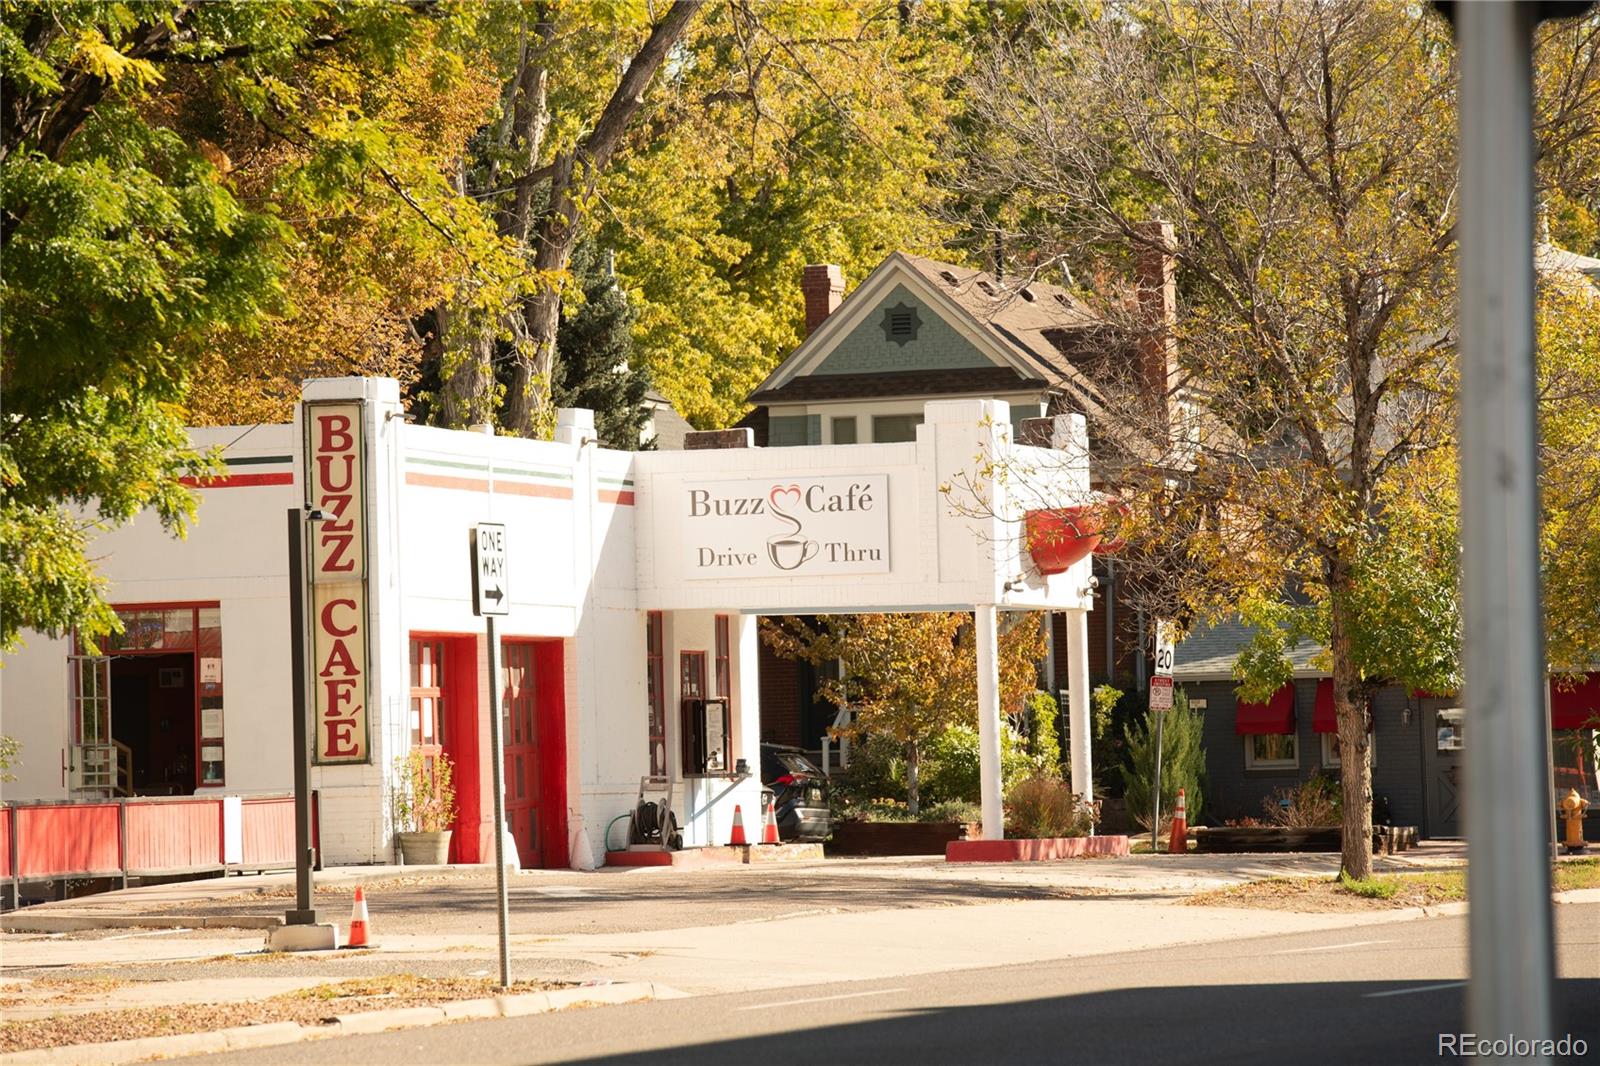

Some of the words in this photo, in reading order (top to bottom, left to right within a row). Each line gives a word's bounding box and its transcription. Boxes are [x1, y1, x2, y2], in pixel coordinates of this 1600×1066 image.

[316, 415, 355, 573] BUZZ
[688, 489, 765, 517] Buzz
[805, 484, 873, 513] Café
[481, 530, 503, 552] ONE
[481, 556, 504, 578] WAY
[697, 548, 757, 567] Drive
[825, 542, 881, 562] Thru
[1157, 649, 1172, 669] 20
[319, 599, 361, 757] CAFÉ
